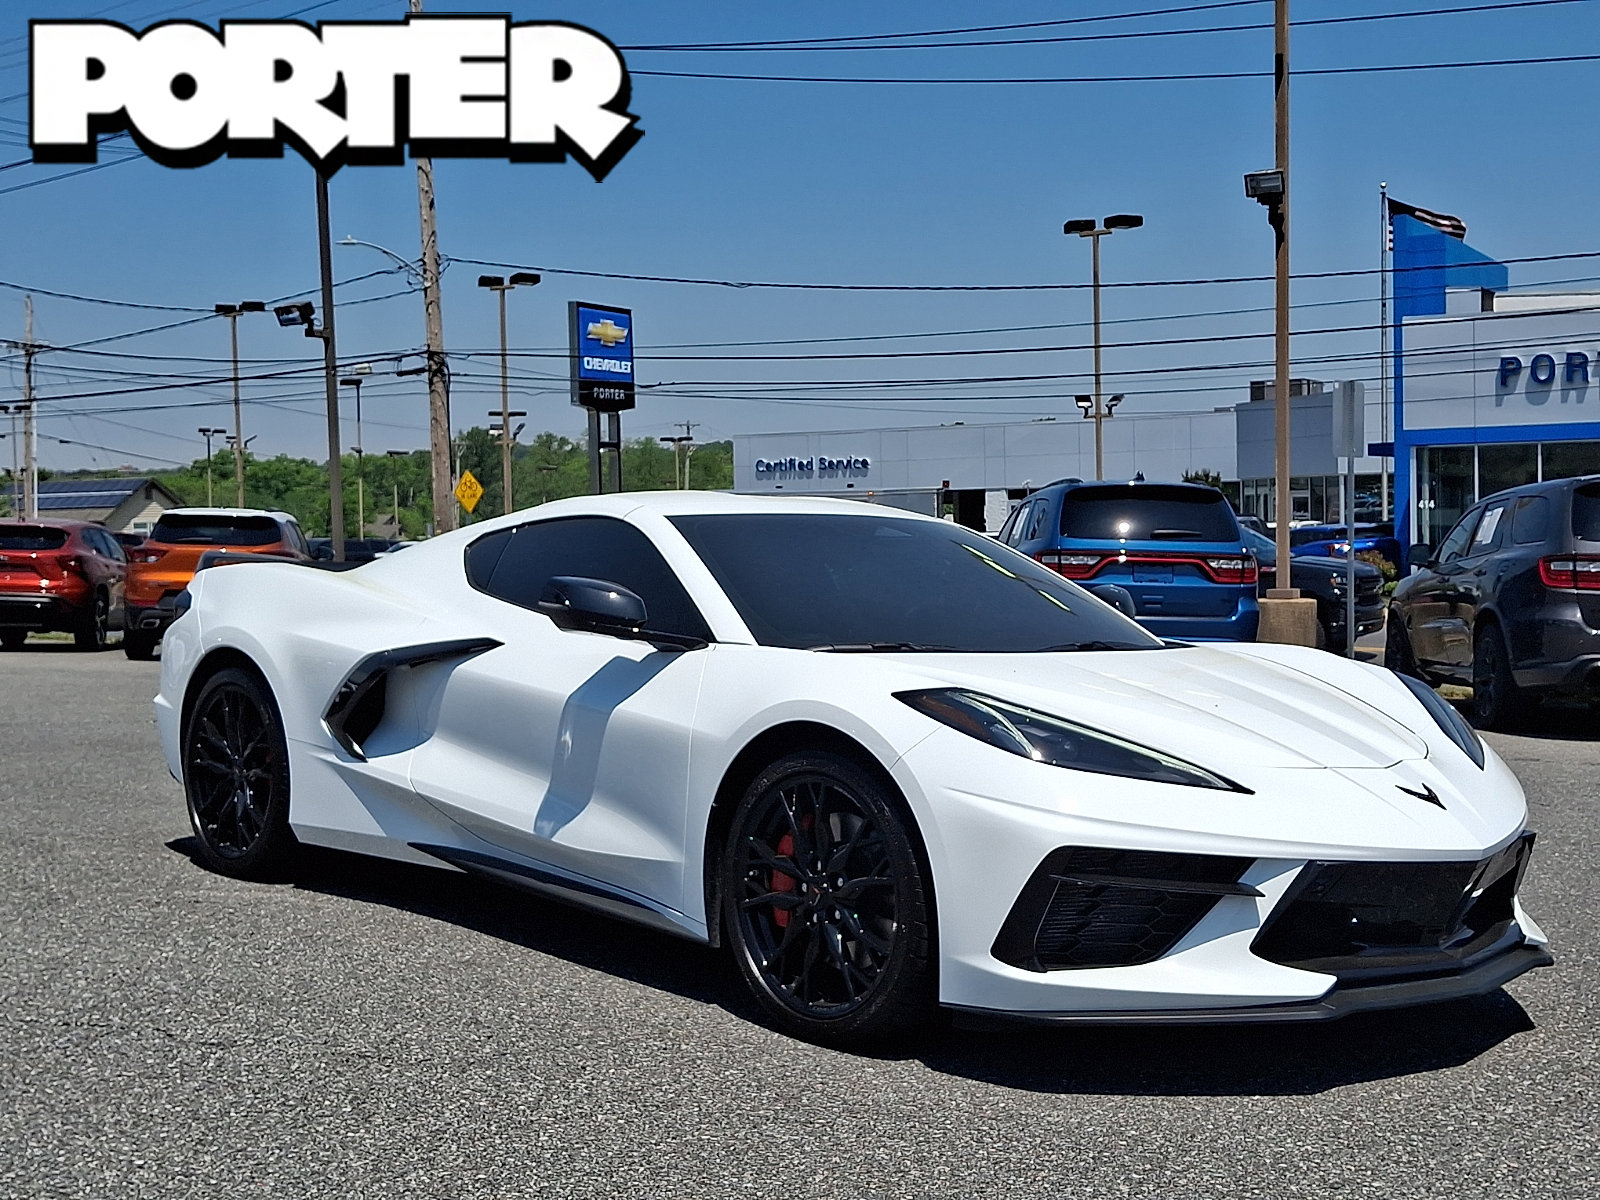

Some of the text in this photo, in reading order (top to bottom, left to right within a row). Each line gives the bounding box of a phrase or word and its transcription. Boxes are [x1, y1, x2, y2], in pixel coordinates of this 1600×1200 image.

[584, 357, 632, 373] CHEVROLET
[1500, 351, 1600, 387] POR
[593, 387, 625, 400] PORTER
[756, 455, 870, 473] Certified Service
[1418, 499, 1435, 509] 414
